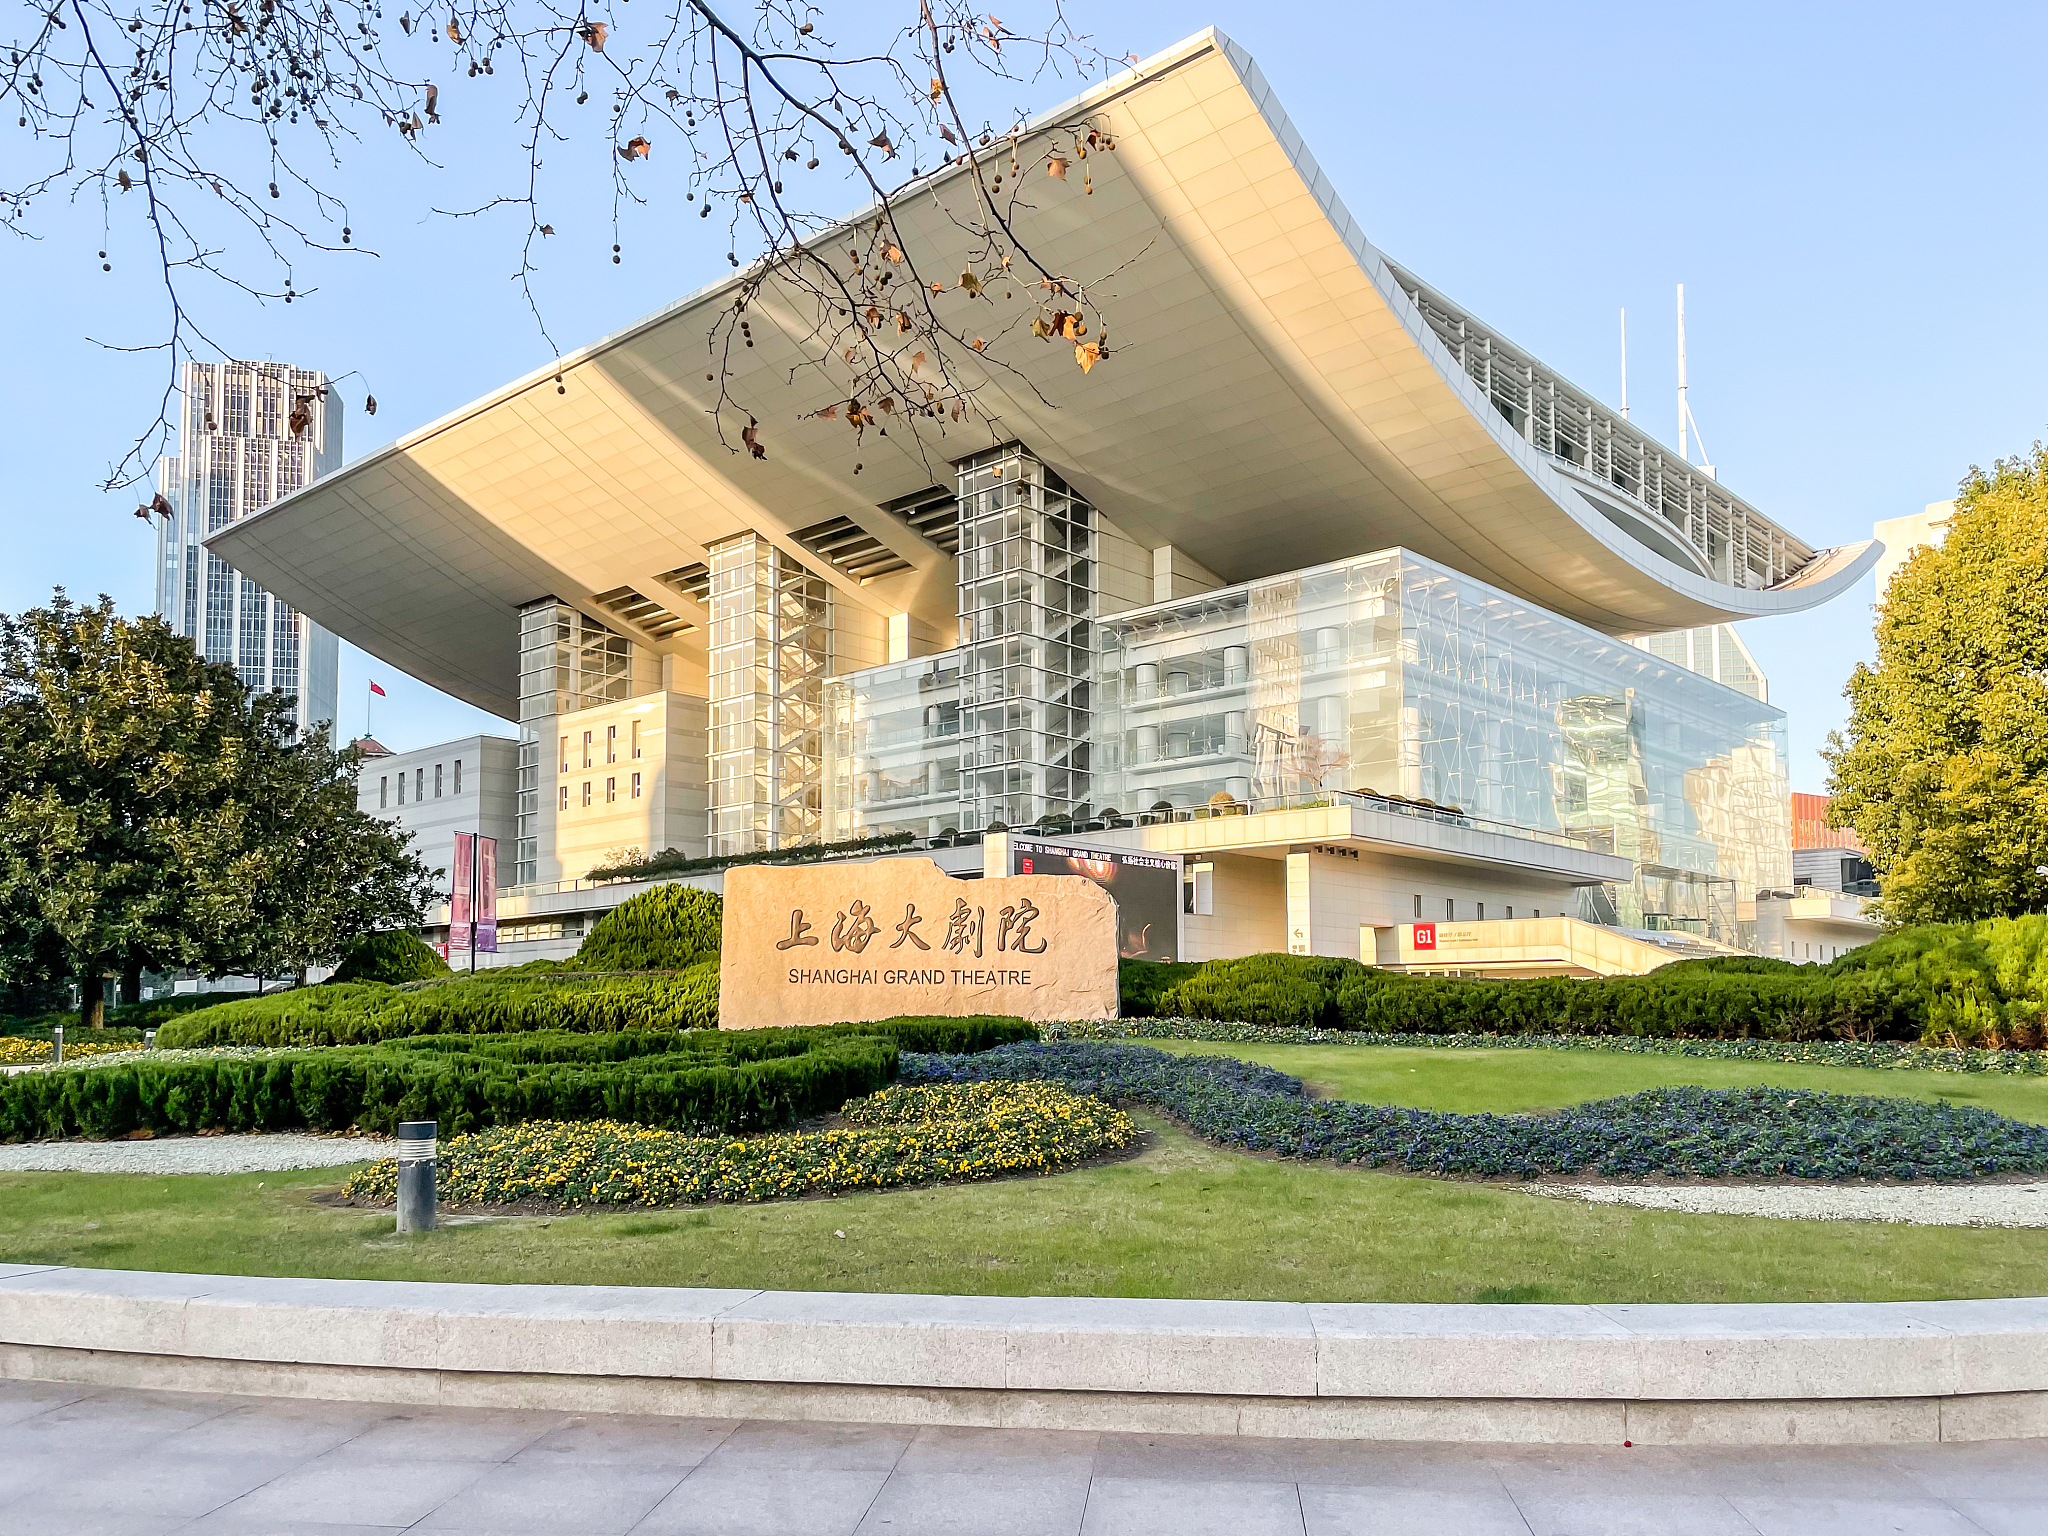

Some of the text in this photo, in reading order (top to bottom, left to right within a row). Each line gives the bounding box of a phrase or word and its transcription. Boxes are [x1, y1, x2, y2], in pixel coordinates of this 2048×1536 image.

[1036, 845, 1043, 854] TO
[1045, 846, 1070, 857] SHANGHAI
[1072, 850, 1089, 859] GRAND
[1090, 852, 1112, 862] THEATRE
[1122, 855, 1177, 870] 弘扬社会主义核心价值
[1417, 930, 1432, 944] G1
[788, 969, 1032, 985] SHANGHAI GRAND THEATRE
